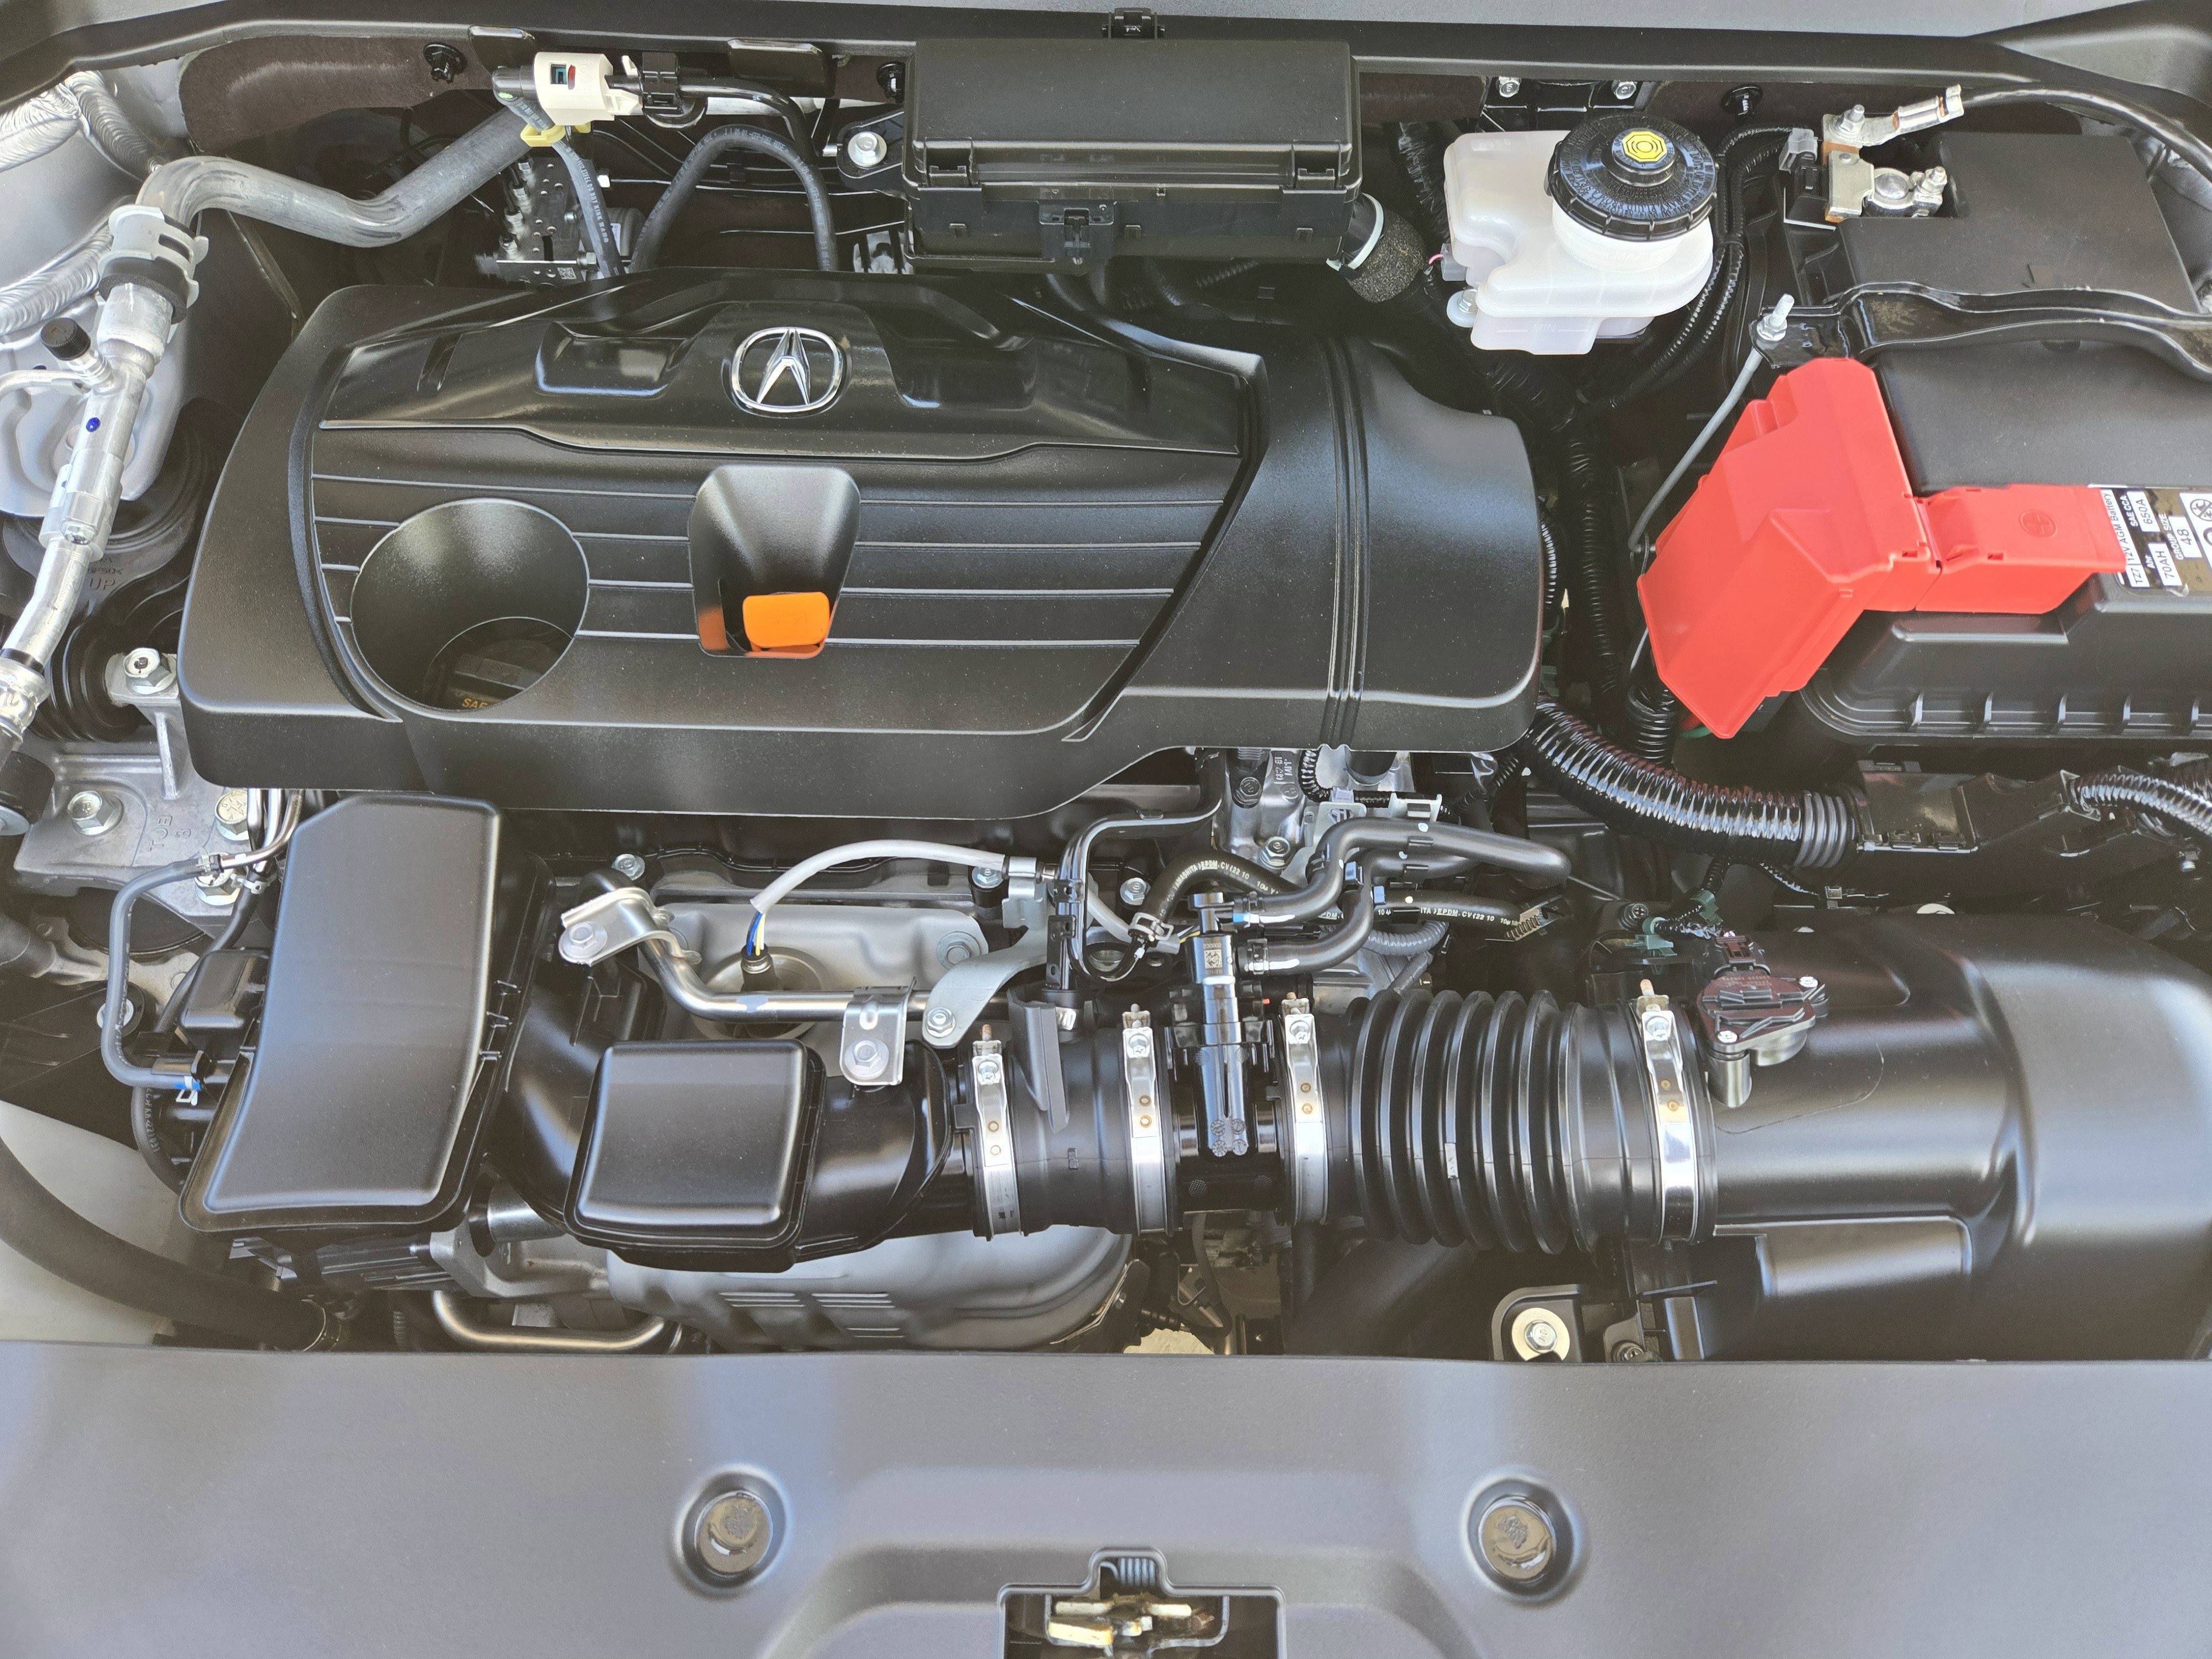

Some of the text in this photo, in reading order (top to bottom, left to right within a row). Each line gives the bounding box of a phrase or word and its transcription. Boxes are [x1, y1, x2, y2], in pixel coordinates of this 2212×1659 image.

[1532, 324, 1557, 333] MIN
[2126, 512, 2139, 527] SAE
[2136, 499, 2153, 525] 650A
[2103, 493, 2143, 585] TZ7 12V AGM Battery
[2158, 513, 2185, 560] GROUP SIZE
[2177, 529, 2192, 545] 48
[2155, 551, 2173, 579] 70AH
[88, 578, 116, 590] UP
